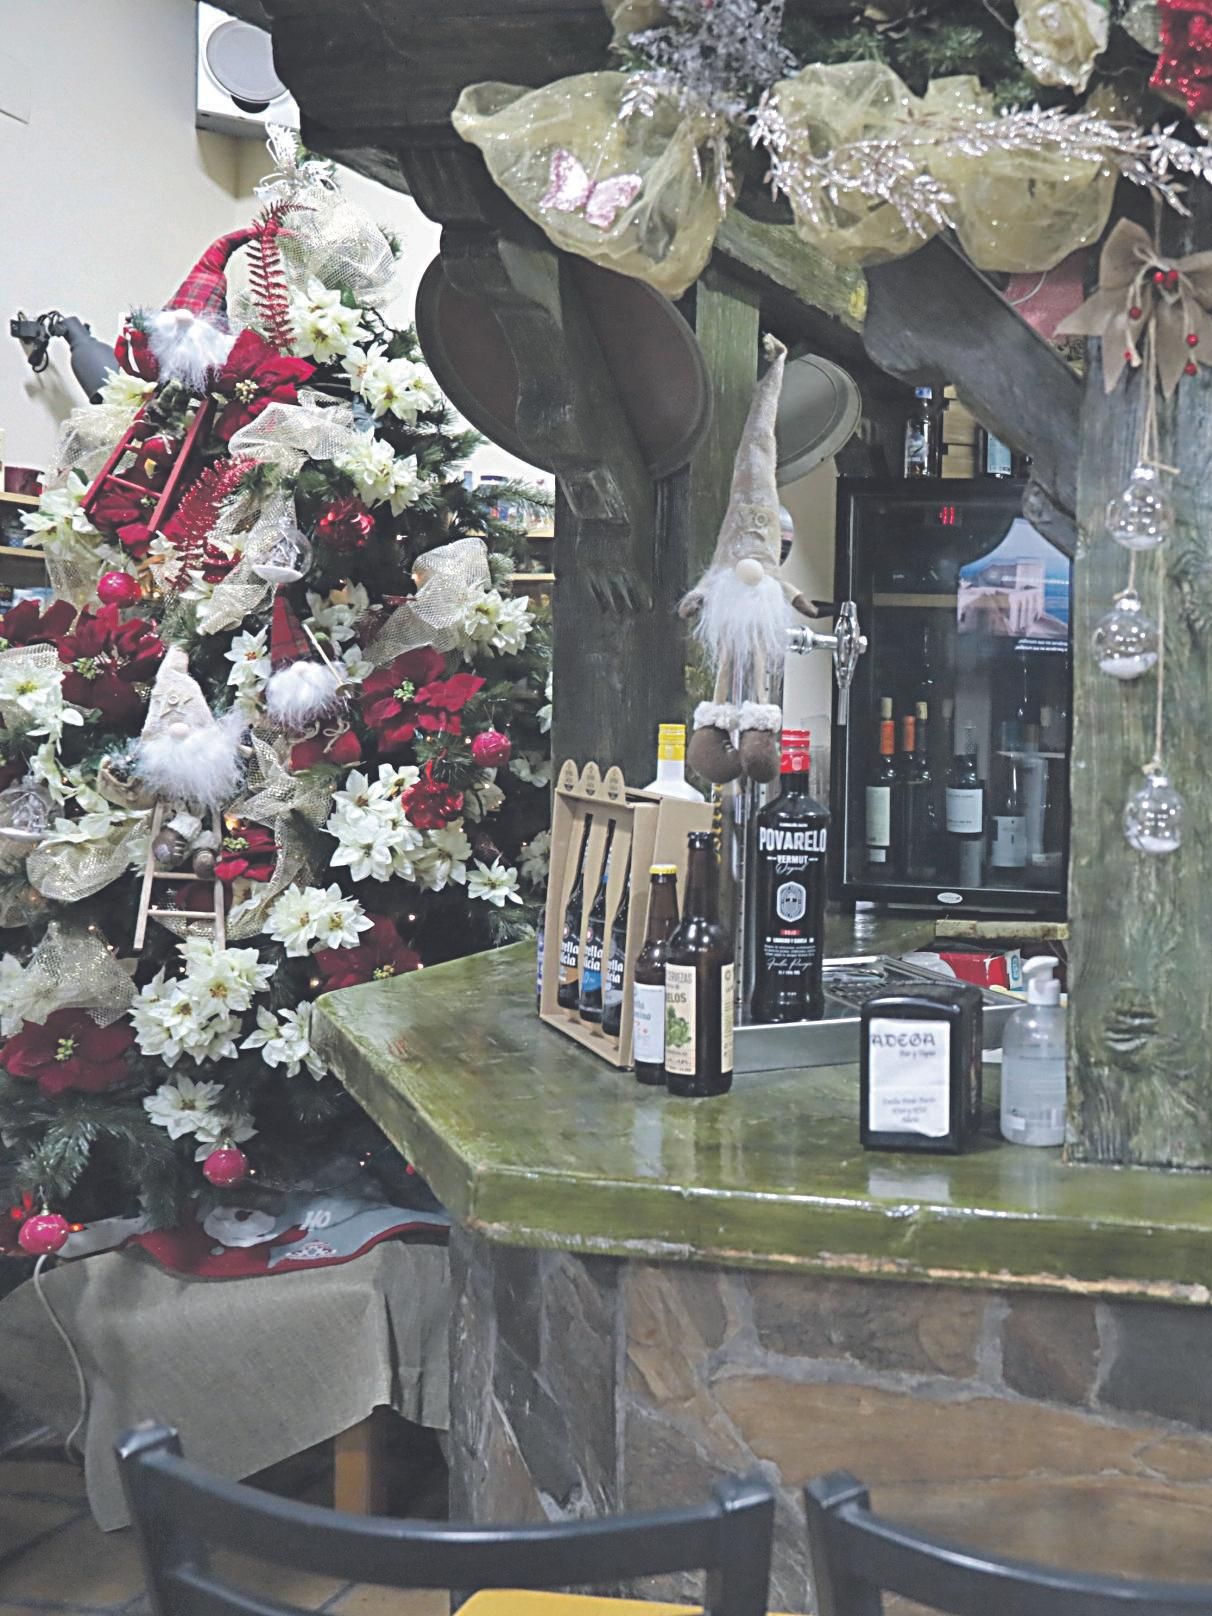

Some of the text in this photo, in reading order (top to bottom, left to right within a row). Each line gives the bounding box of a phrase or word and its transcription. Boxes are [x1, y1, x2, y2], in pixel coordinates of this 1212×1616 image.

[760, 826, 827, 852] POVARELO
[777, 855, 808, 864] VERMUT
[872, 1033, 936, 1047] ADEGA
[299, 1210, 331, 1231] HO
